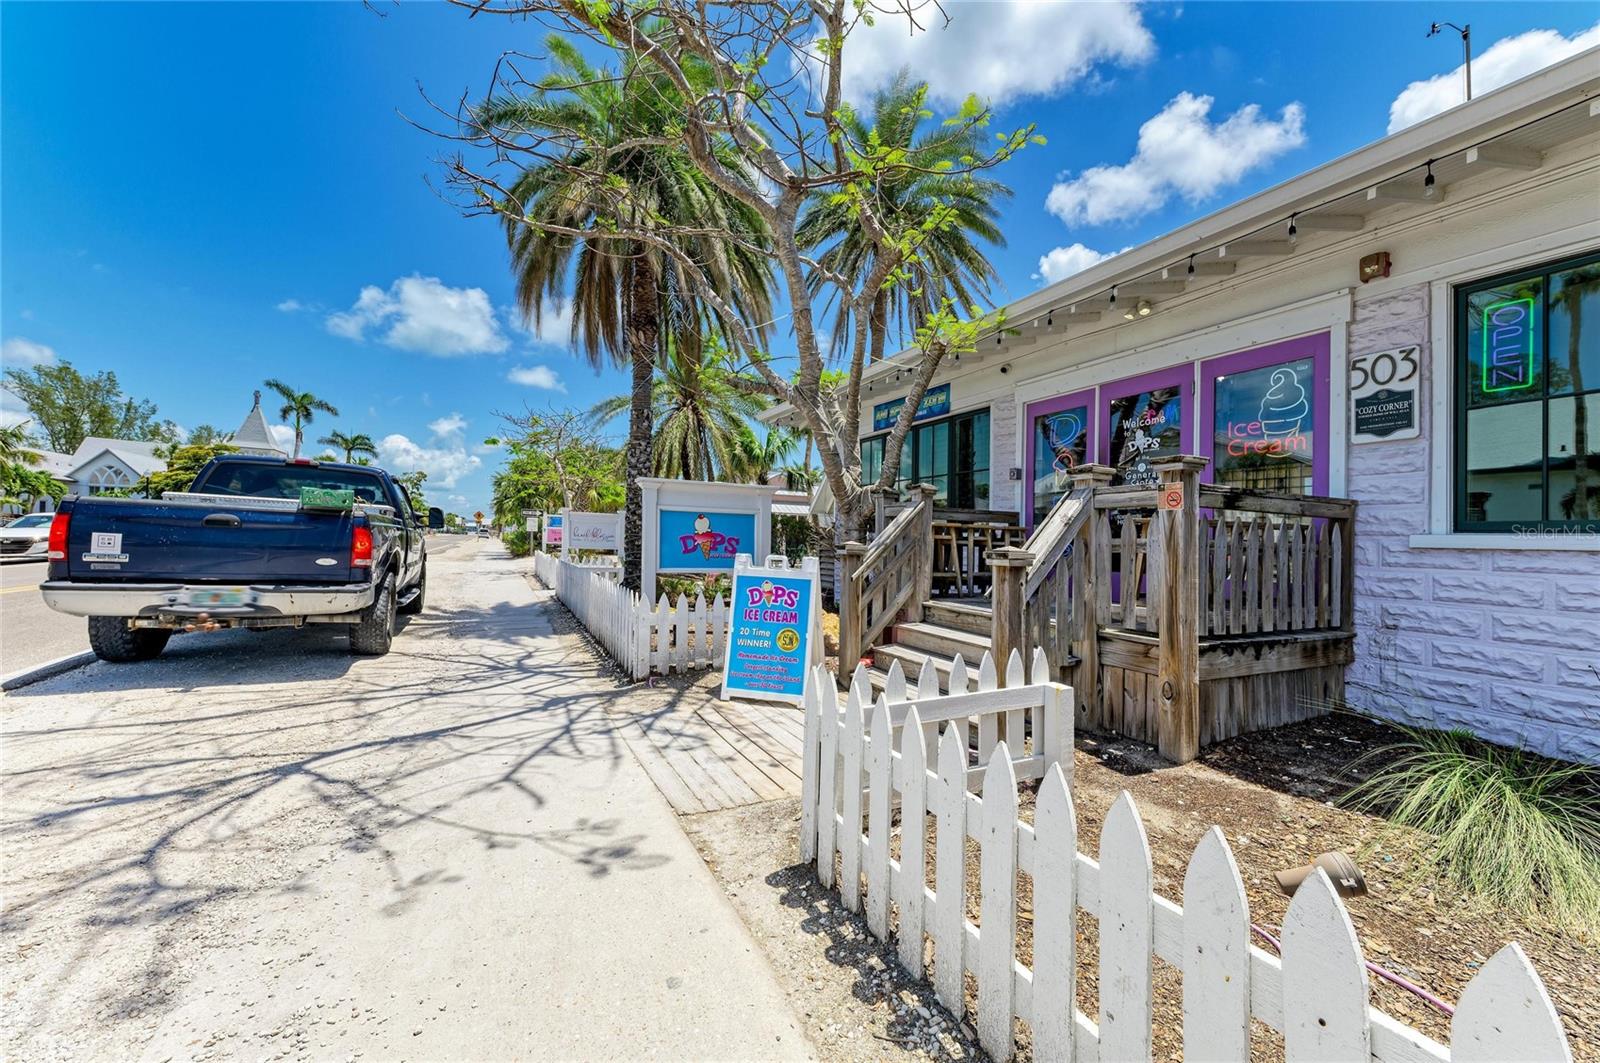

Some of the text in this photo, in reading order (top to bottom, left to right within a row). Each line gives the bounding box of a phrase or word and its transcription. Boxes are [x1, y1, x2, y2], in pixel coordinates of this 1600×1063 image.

[1492, 306, 1525, 386] OPEN
[1351, 347, 1418, 390] 503
[1123, 415, 1165, 429] Welcome
[1227, 421, 1261, 438] Ice
[1227, 436, 1308, 456] Cream
[744, 608, 798, 624] ICE CREAM
[740, 627, 771, 637] 20 Time
[737, 638, 771, 648] WINNER!
